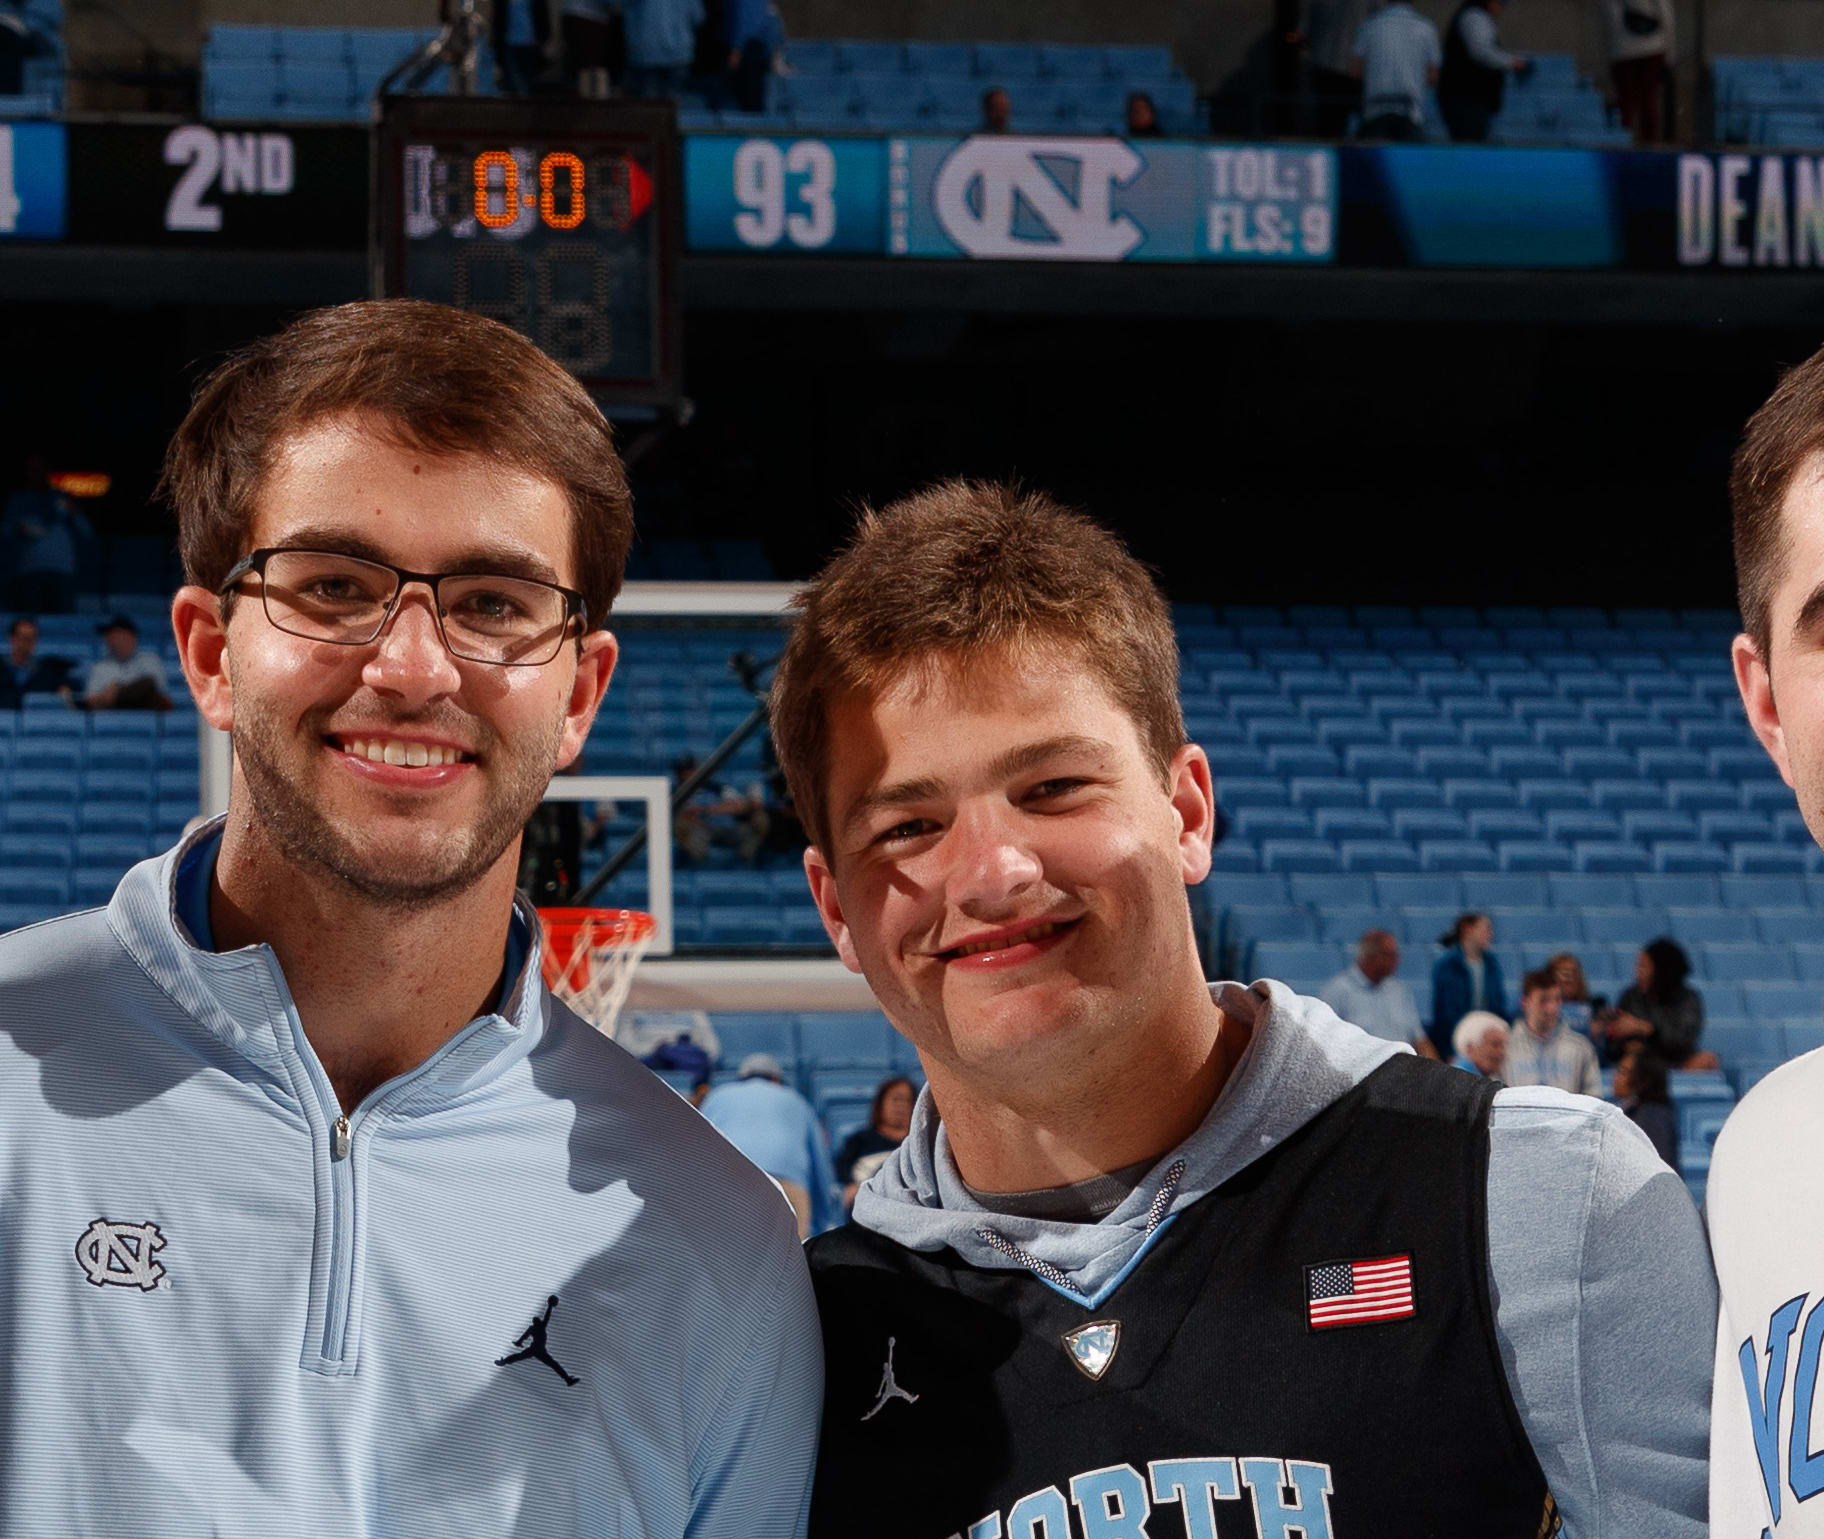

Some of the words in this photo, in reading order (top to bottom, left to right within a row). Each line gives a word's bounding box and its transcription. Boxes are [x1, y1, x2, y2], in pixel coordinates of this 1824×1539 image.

[165, 124, 294, 231] 2ND
[733, 139, 836, 249] 93
[1207, 150, 1296, 198] TOL:
[1208, 205, 1296, 254] FLS:
[1300, 206, 1331, 256] 9
